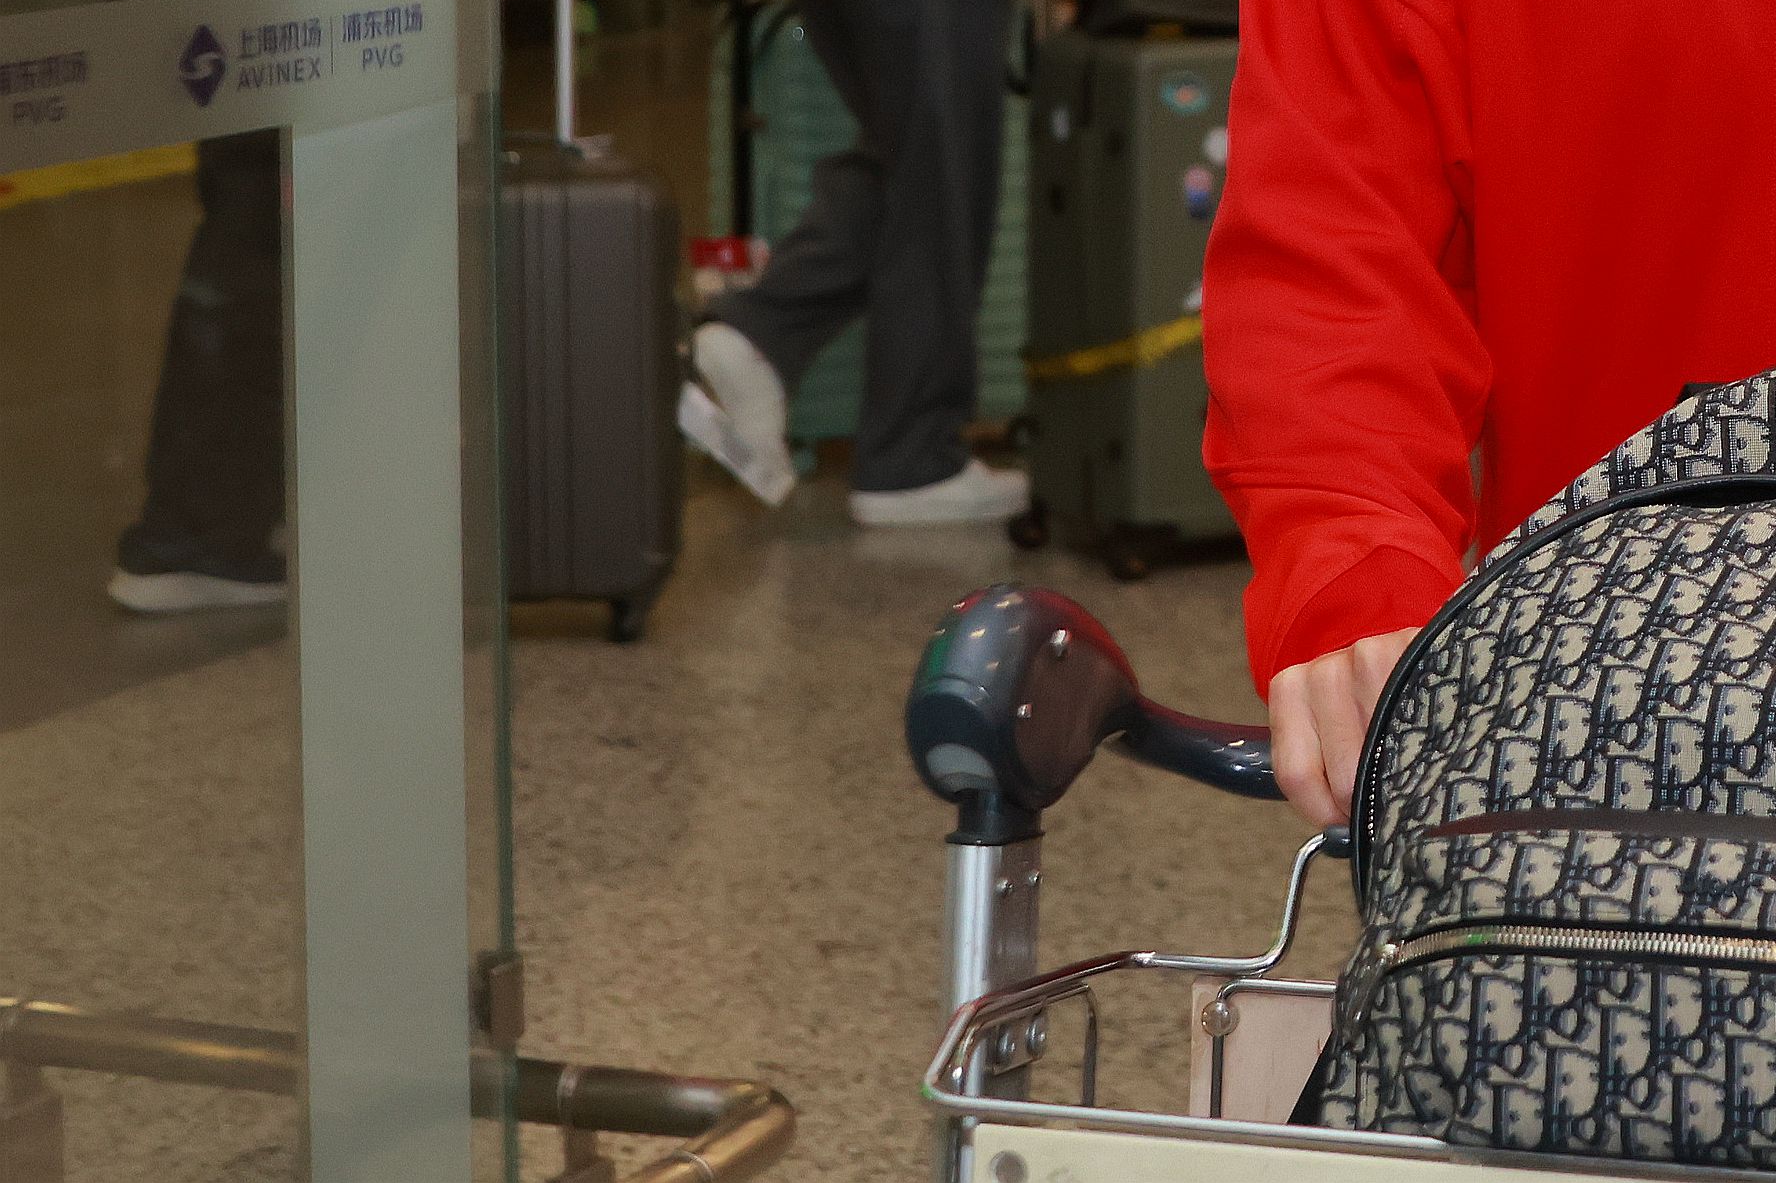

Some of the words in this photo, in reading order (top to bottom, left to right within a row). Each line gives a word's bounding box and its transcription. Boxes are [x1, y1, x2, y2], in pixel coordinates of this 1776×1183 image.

[238, 16, 322, 60] 上海机场
[342, 2, 424, 44] 浦东机场
[236, 56, 322, 92] AVINEX
[361, 43, 405, 73] PVG
